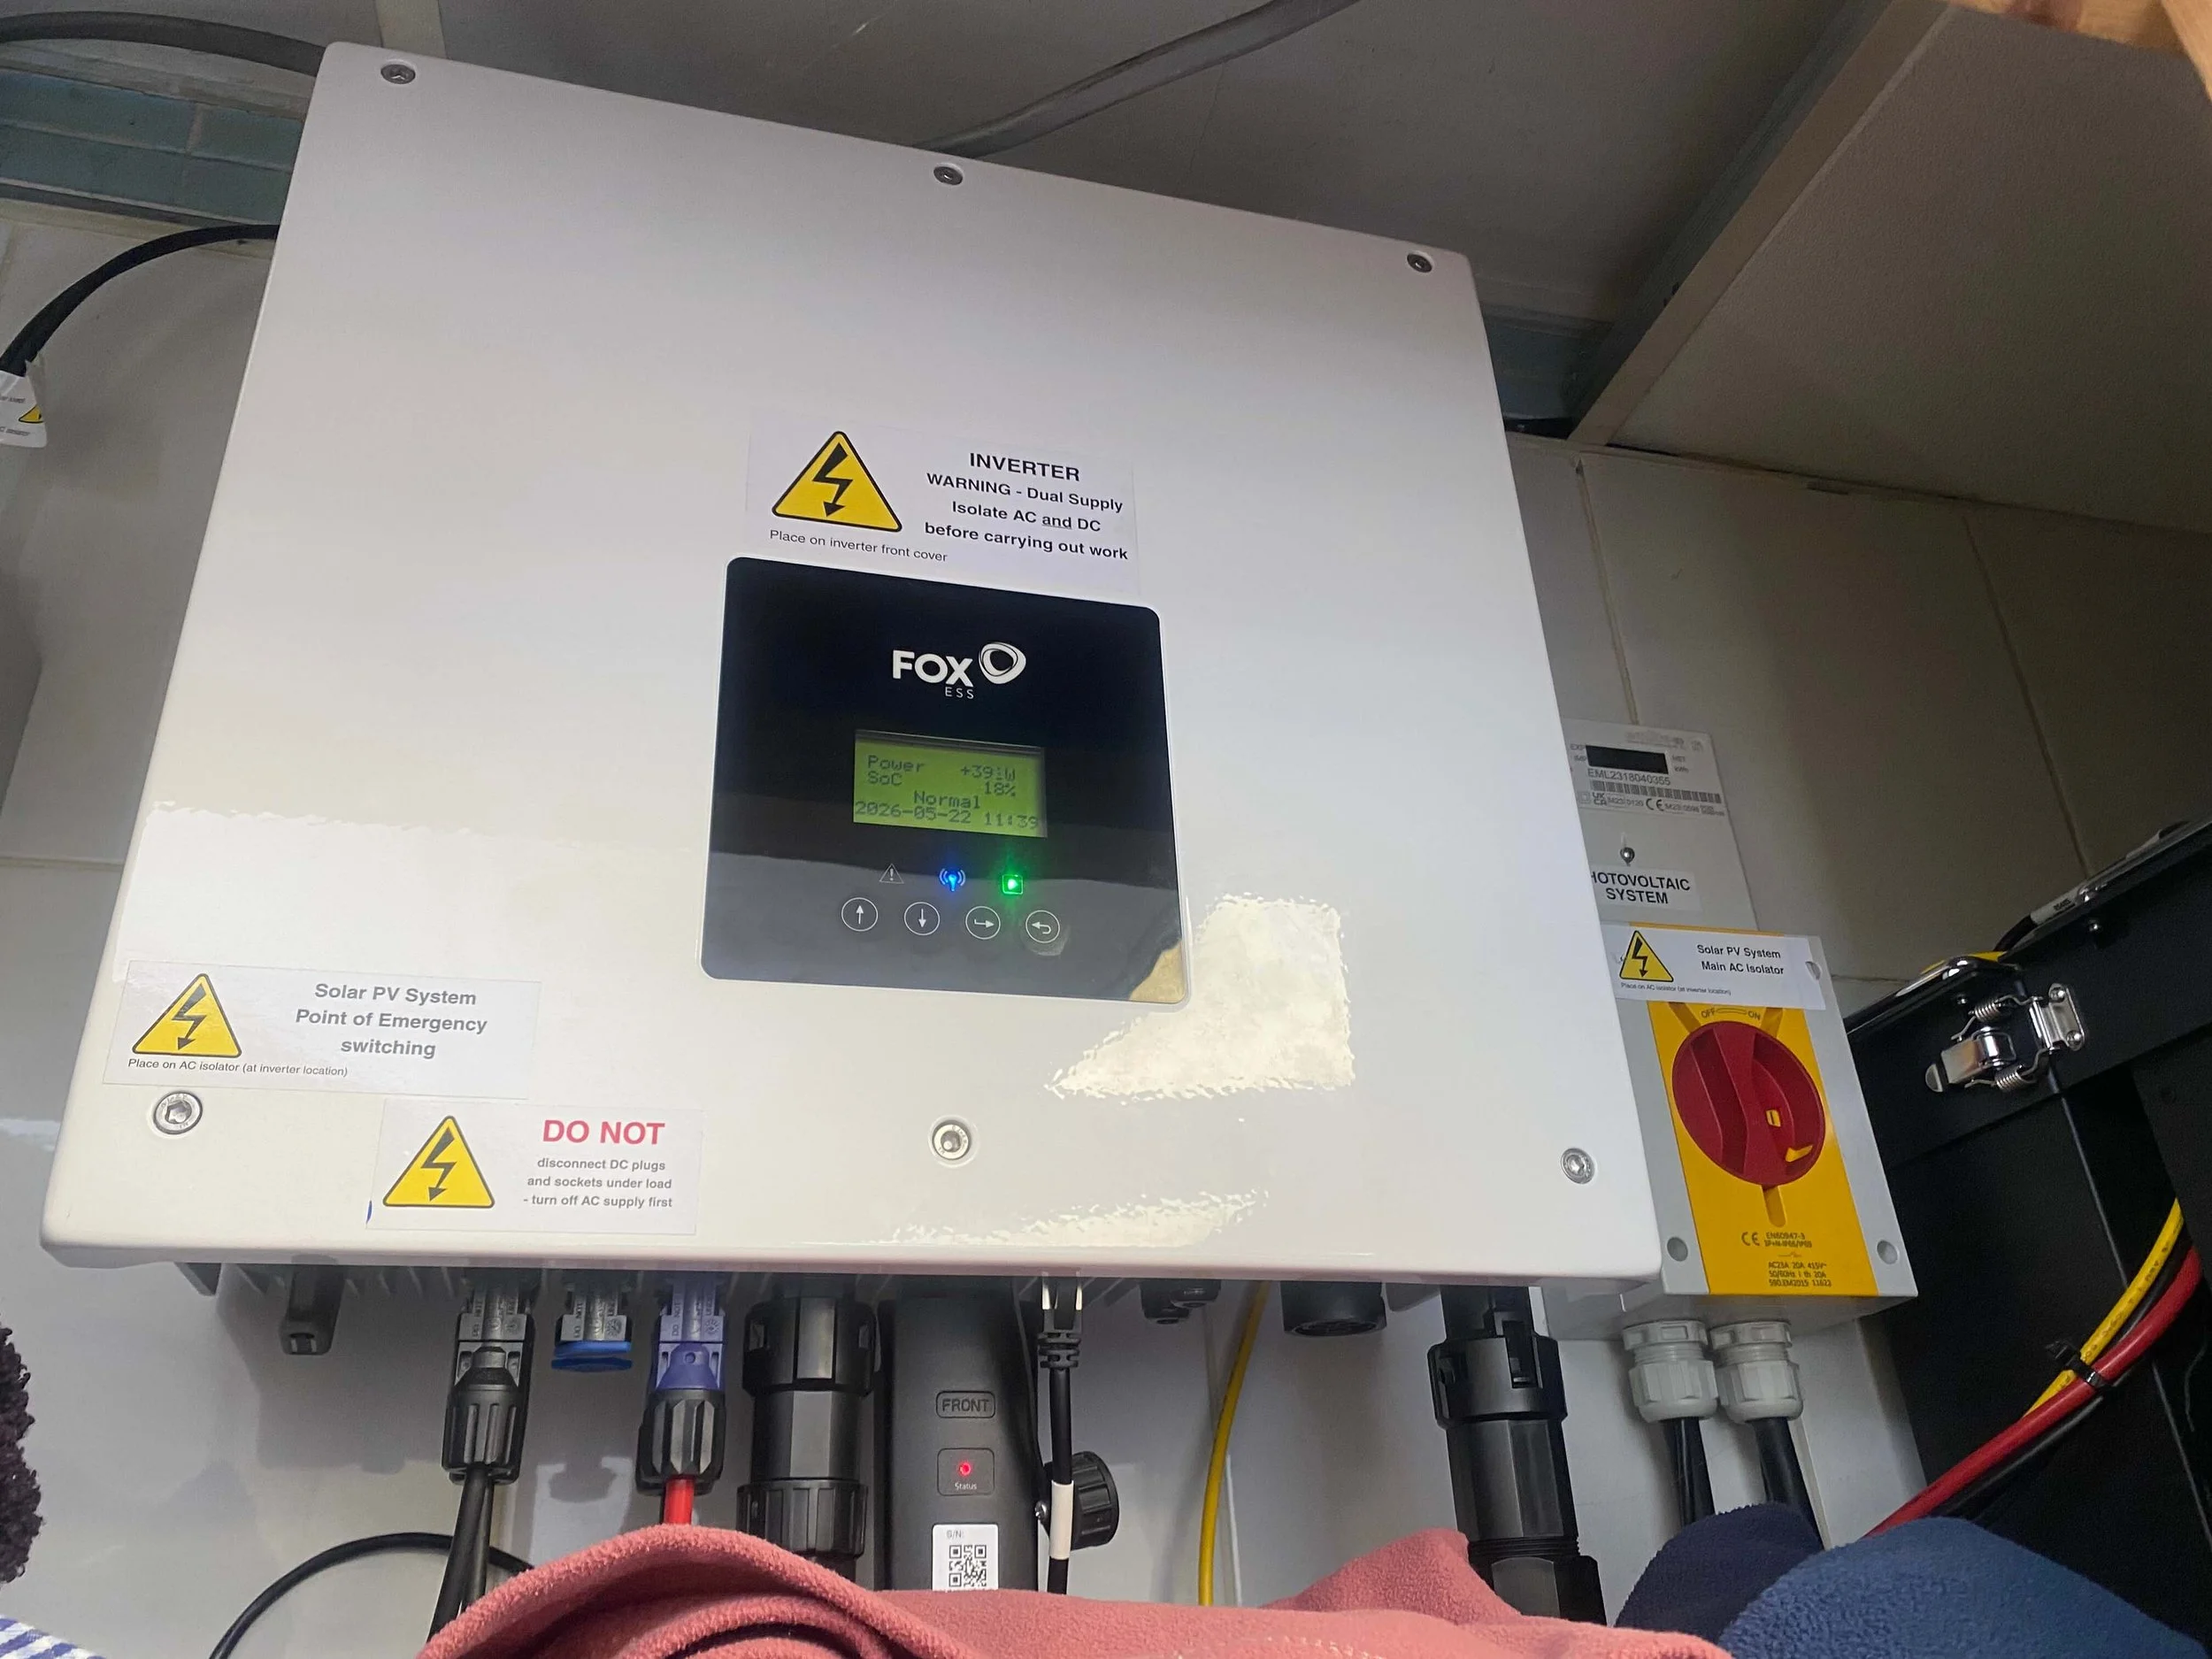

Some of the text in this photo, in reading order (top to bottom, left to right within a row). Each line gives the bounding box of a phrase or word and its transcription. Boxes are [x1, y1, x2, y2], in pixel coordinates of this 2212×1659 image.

[970, 452, 1080, 482] INVERTER
[926, 472, 1011, 495] WARNING
[1026, 488, 1064, 503] Dual
[1068, 493, 1123, 514] Supply
[952, 501, 1102, 532] Isolate AC and DC
[770, 529, 949, 562] Place on inverter front cover
[925, 522, 1128, 560] before carrying out work
[893, 649, 974, 687] FOX
[944, 687, 974, 699] ESS
[865, 754, 925, 773] Power
[865, 770, 1017, 796] SoC 18%
[914, 790, 981, 810] Normal
[855, 801, 1039, 830] 2026-05-22 11:39
[1591, 871, 1691, 891] HOTOVOLTAIC
[1605, 887, 1669, 904] SYSTEM
[1697, 944, 1781, 959] Solar PV System
[1701, 961, 1784, 975] Main AC Isolator
[314, 983, 477, 1007] Solar PV System
[296, 1009, 488, 1035] Point of Emergency
[1701, 1008, 1716, 1018] OFF
[1748, 1010, 1761, 1020] ON
[340, 1038, 436, 1060] switching
[127, 1058, 349, 1078] Place on AC isolator (at inverter location)
[542, 1119, 665, 1145] DO NOT
[537, 1157, 665, 1172] disconnect DC plugs
[527, 1177, 672, 1189] and sockets under load
[532, 1194, 557, 1205] turn
[561, 1195, 578, 1205] off
[581, 1196, 600, 1206] AC
[603, 1197, 644, 1210] supply
[649, 1197, 672, 1208] first
[941, 1398, 990, 1412] FRONT
[954, 1481, 977, 1491] Status
